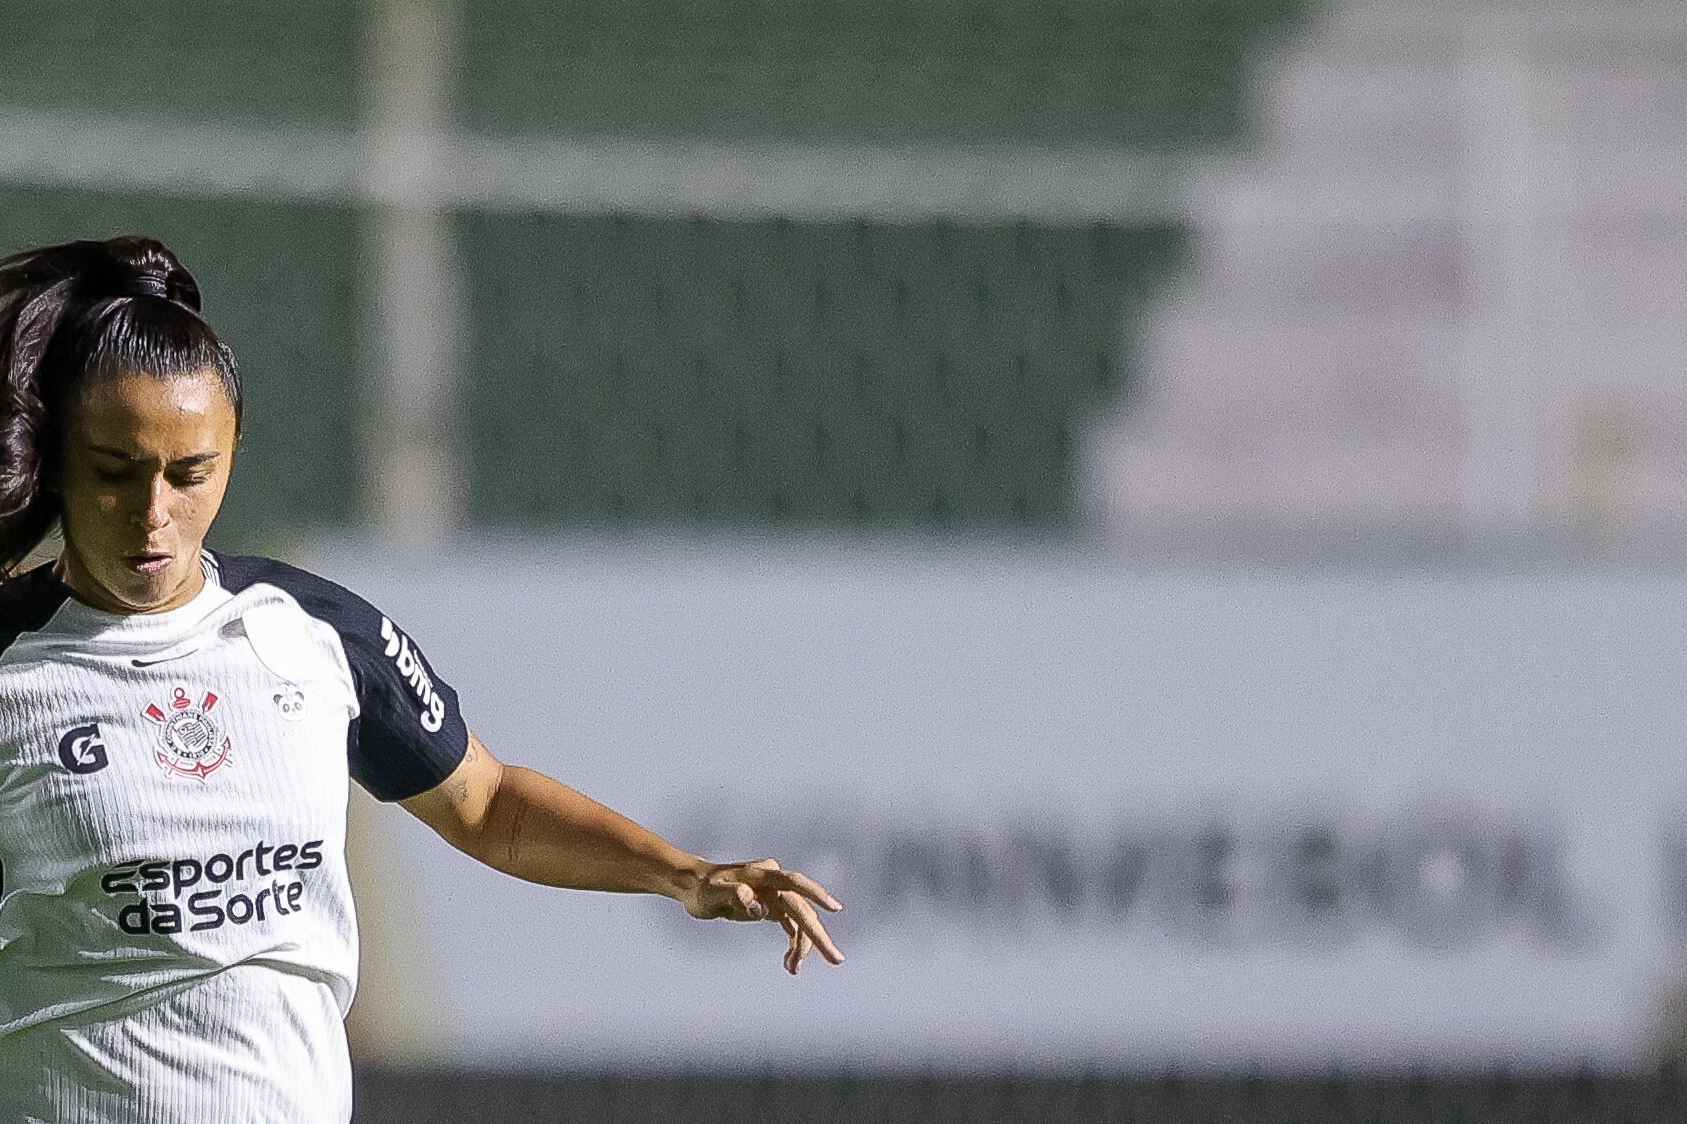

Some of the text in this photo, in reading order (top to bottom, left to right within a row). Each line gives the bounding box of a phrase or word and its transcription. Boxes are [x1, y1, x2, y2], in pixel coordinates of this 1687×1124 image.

[396, 633, 445, 733] bmg
[58, 723, 109, 775] G
[101, 839, 325, 900] Esportes
[118, 877, 304, 935] da Sorte
